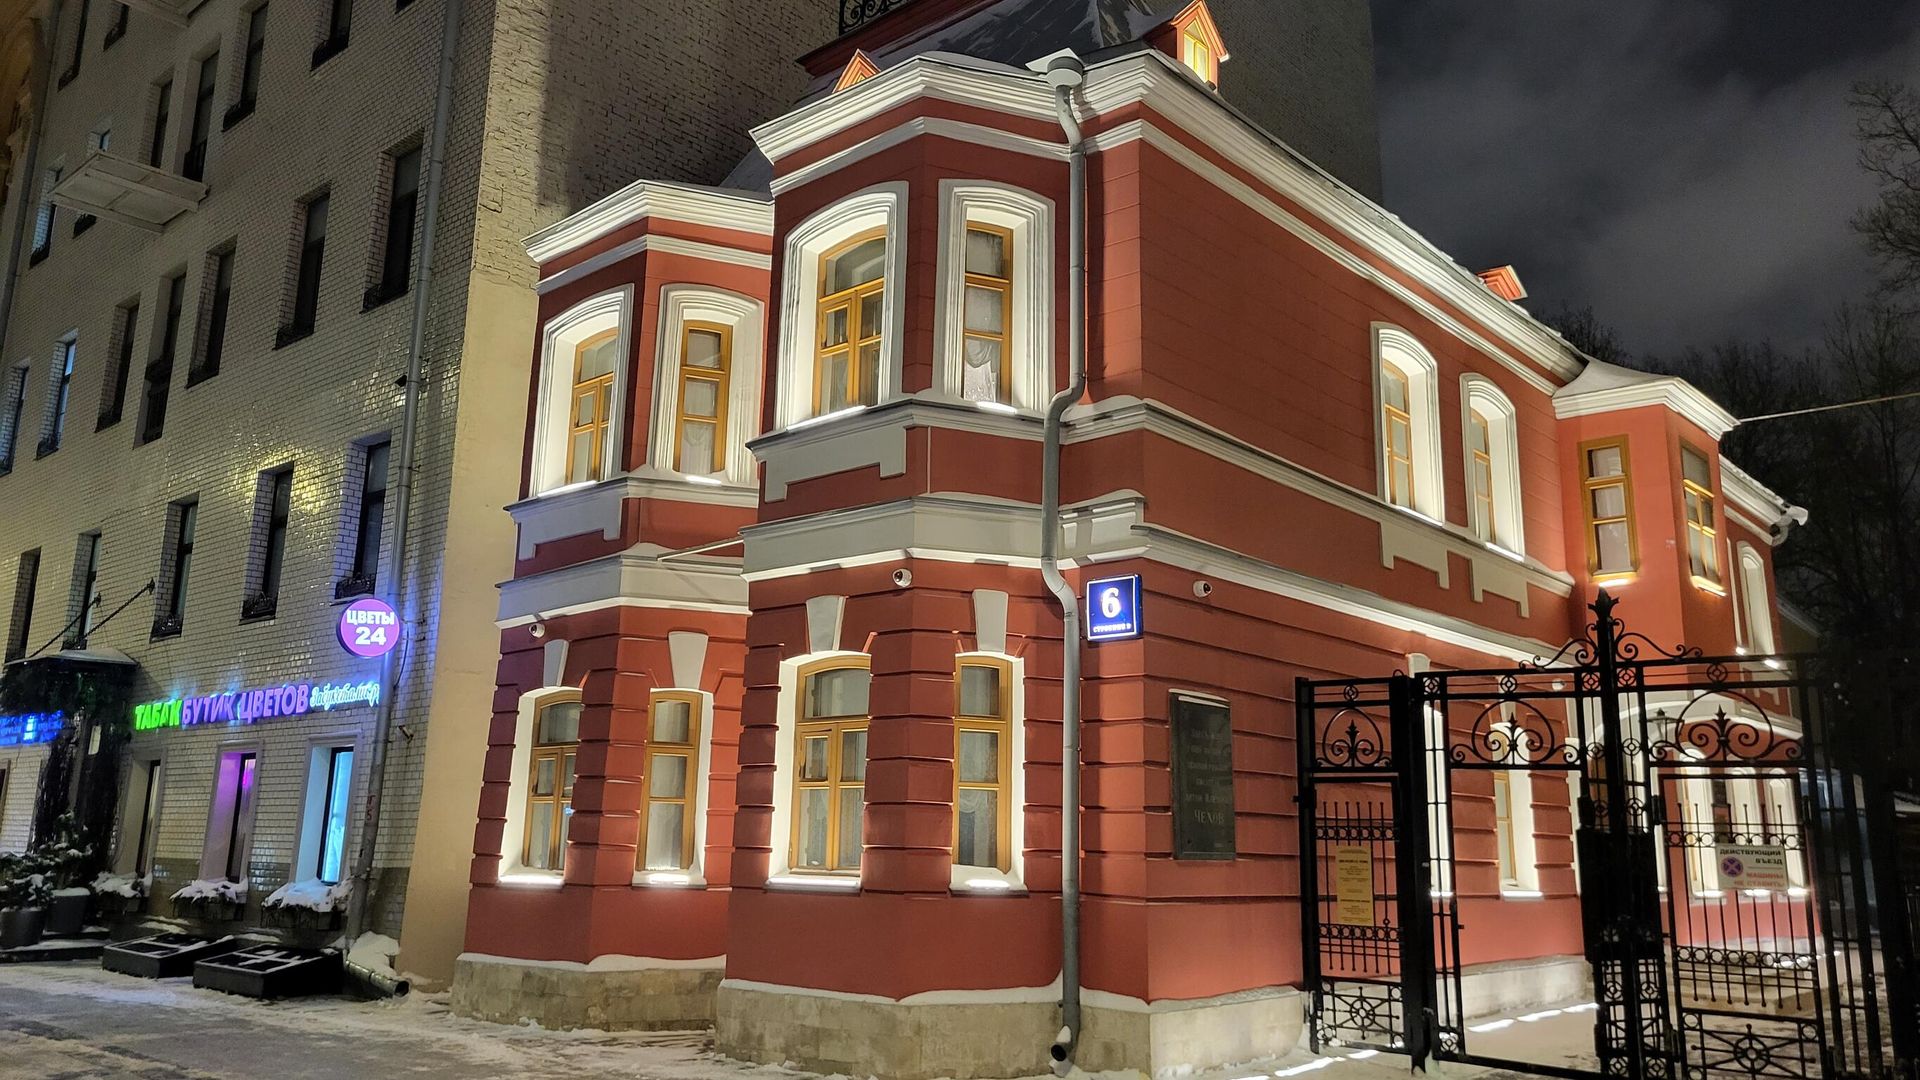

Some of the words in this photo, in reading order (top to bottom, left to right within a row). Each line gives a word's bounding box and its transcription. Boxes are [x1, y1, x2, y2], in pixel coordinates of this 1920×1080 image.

[1101, 587, 1121, 618] 6
[346, 610, 395, 626] ЦВЕТЫ
[355, 626, 387, 646] 24
[135, 700, 182, 730] ТАБАК
[182, 697, 234, 725] БУТИК
[238, 684, 309, 724] ЦВЕТОВ
[1194, 809, 1224, 825] ЧЕХОВ
